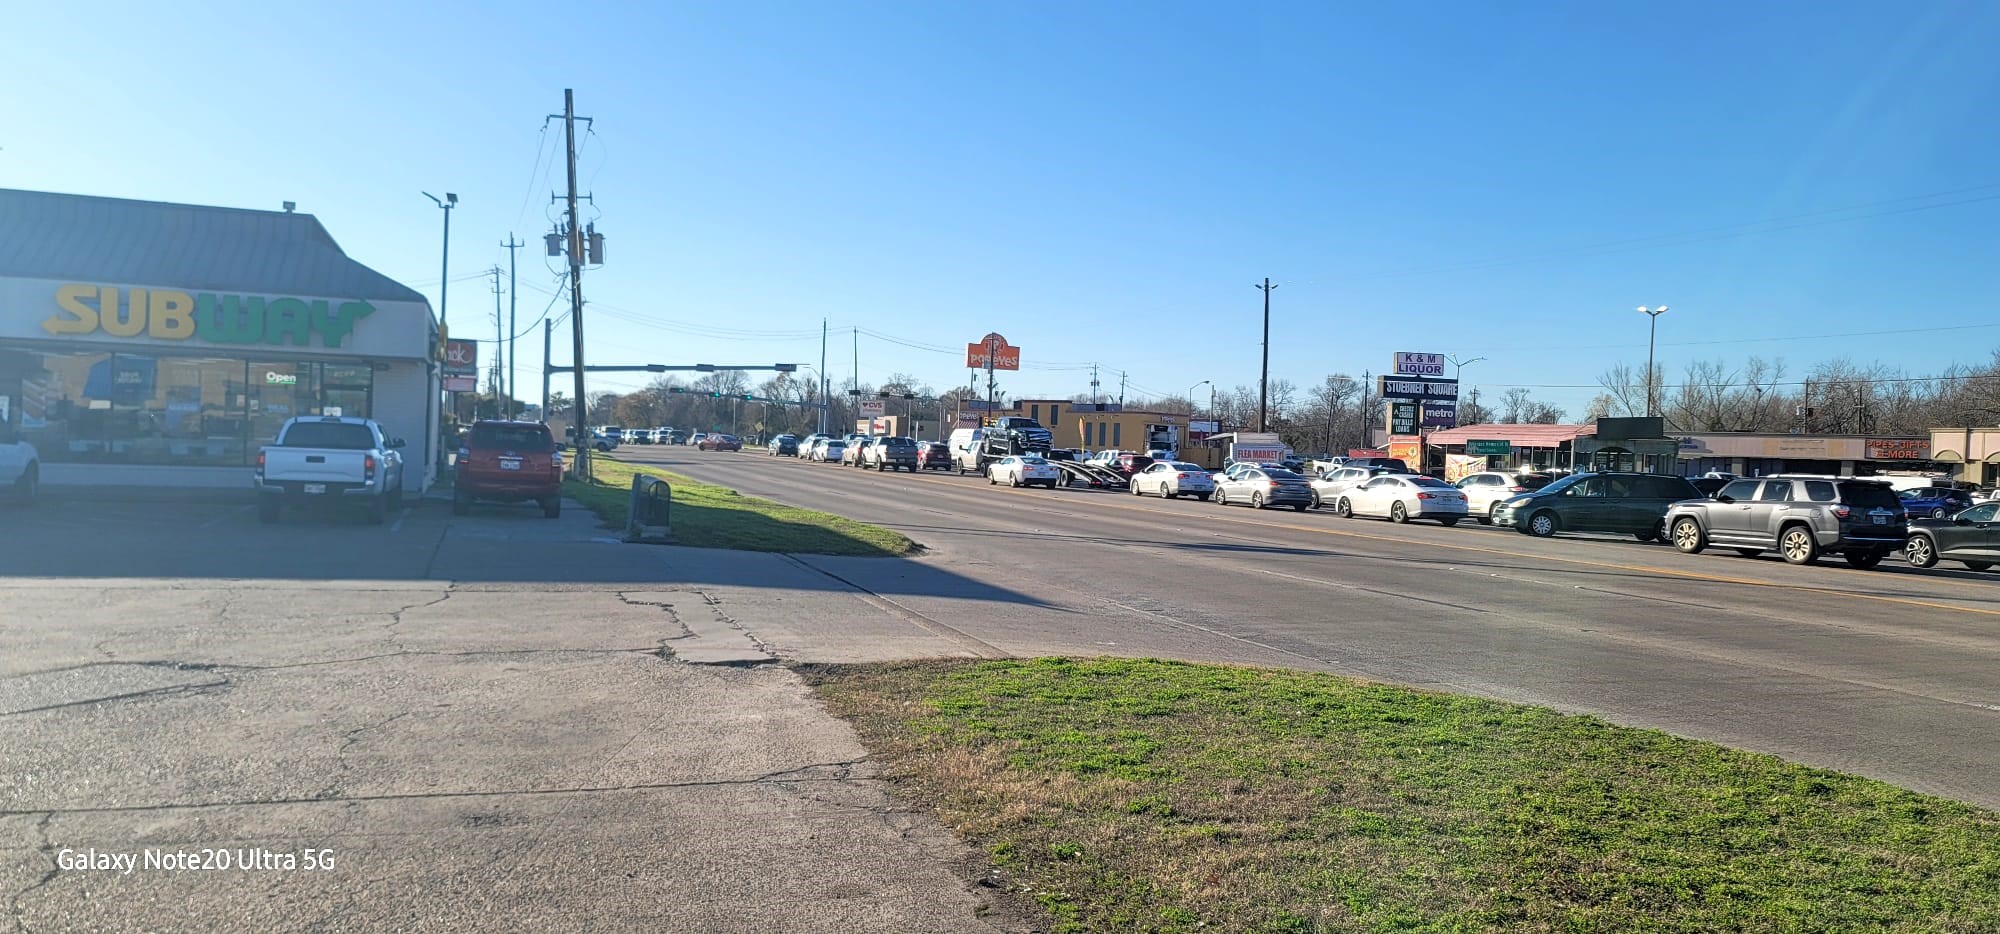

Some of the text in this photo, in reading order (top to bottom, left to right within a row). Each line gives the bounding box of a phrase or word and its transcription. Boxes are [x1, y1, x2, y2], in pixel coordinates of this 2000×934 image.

[42, 284, 376, 348] SUBWAY
[1405, 353, 1436, 363] K & M
[1398, 364, 1442, 374] LIQUOR
[265, 371, 297, 383] Open
[1427, 383, 1458, 396] SQUARE
[1425, 408, 1454, 418] metro
[1237, 449, 1278, 459] FLEA MARKET
[1887, 450, 1919, 459] MORE
